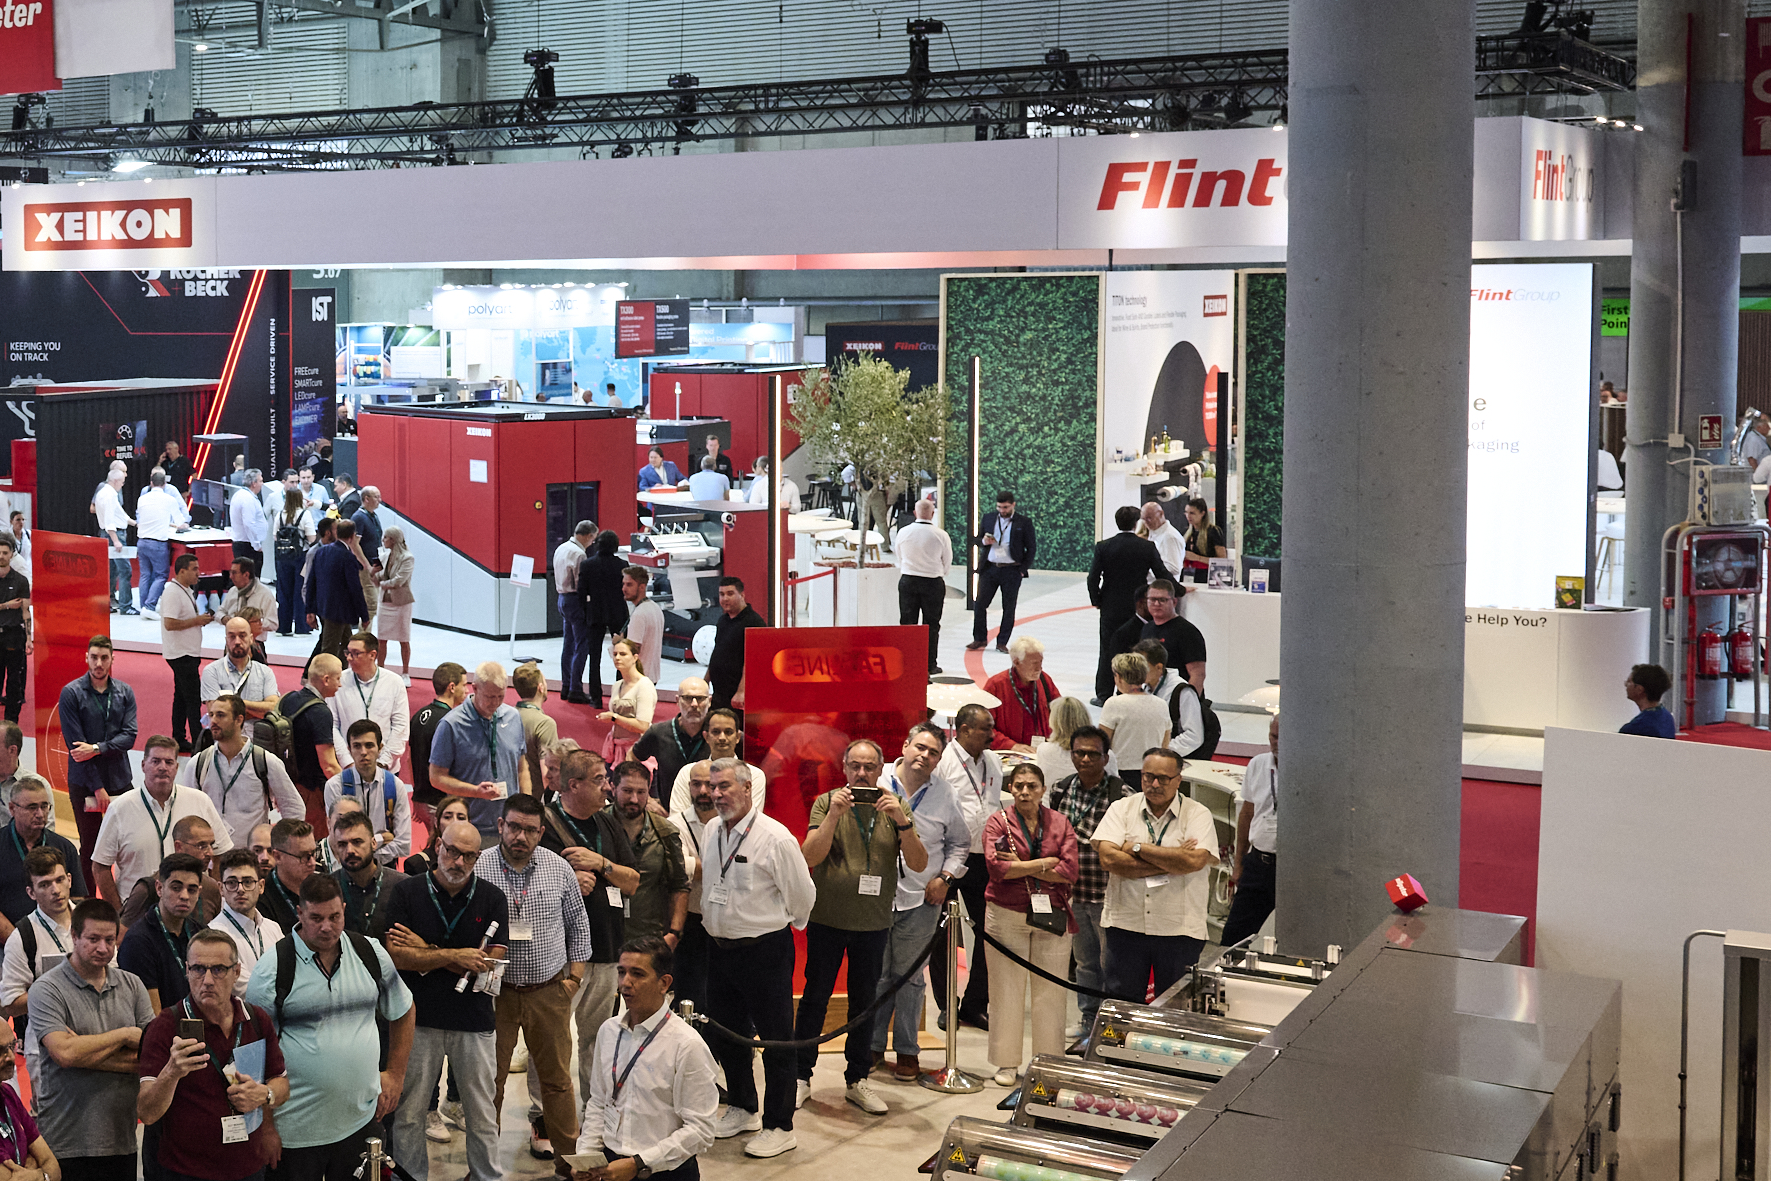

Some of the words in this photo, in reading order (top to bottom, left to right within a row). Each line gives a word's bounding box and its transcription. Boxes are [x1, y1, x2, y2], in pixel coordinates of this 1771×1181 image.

[1096, 158, 1286, 211] Flint
[34, 207, 181, 242] XEIKON
[184, 280, 229, 297] BECK
[311, 295, 333, 321] IST
[1601, 319, 1627, 329] Poin
[10, 342, 42, 351] KEEPING
[43, 342, 61, 351] YOU
[846, 342, 883, 350] XEIKON
[894, 342, 938, 351] FlintGrou
[10, 353, 22, 361] ON
[24, 353, 49, 361] TRACK
[1477, 613, 1509, 627] Help
[1513, 615, 1548, 628] You?
